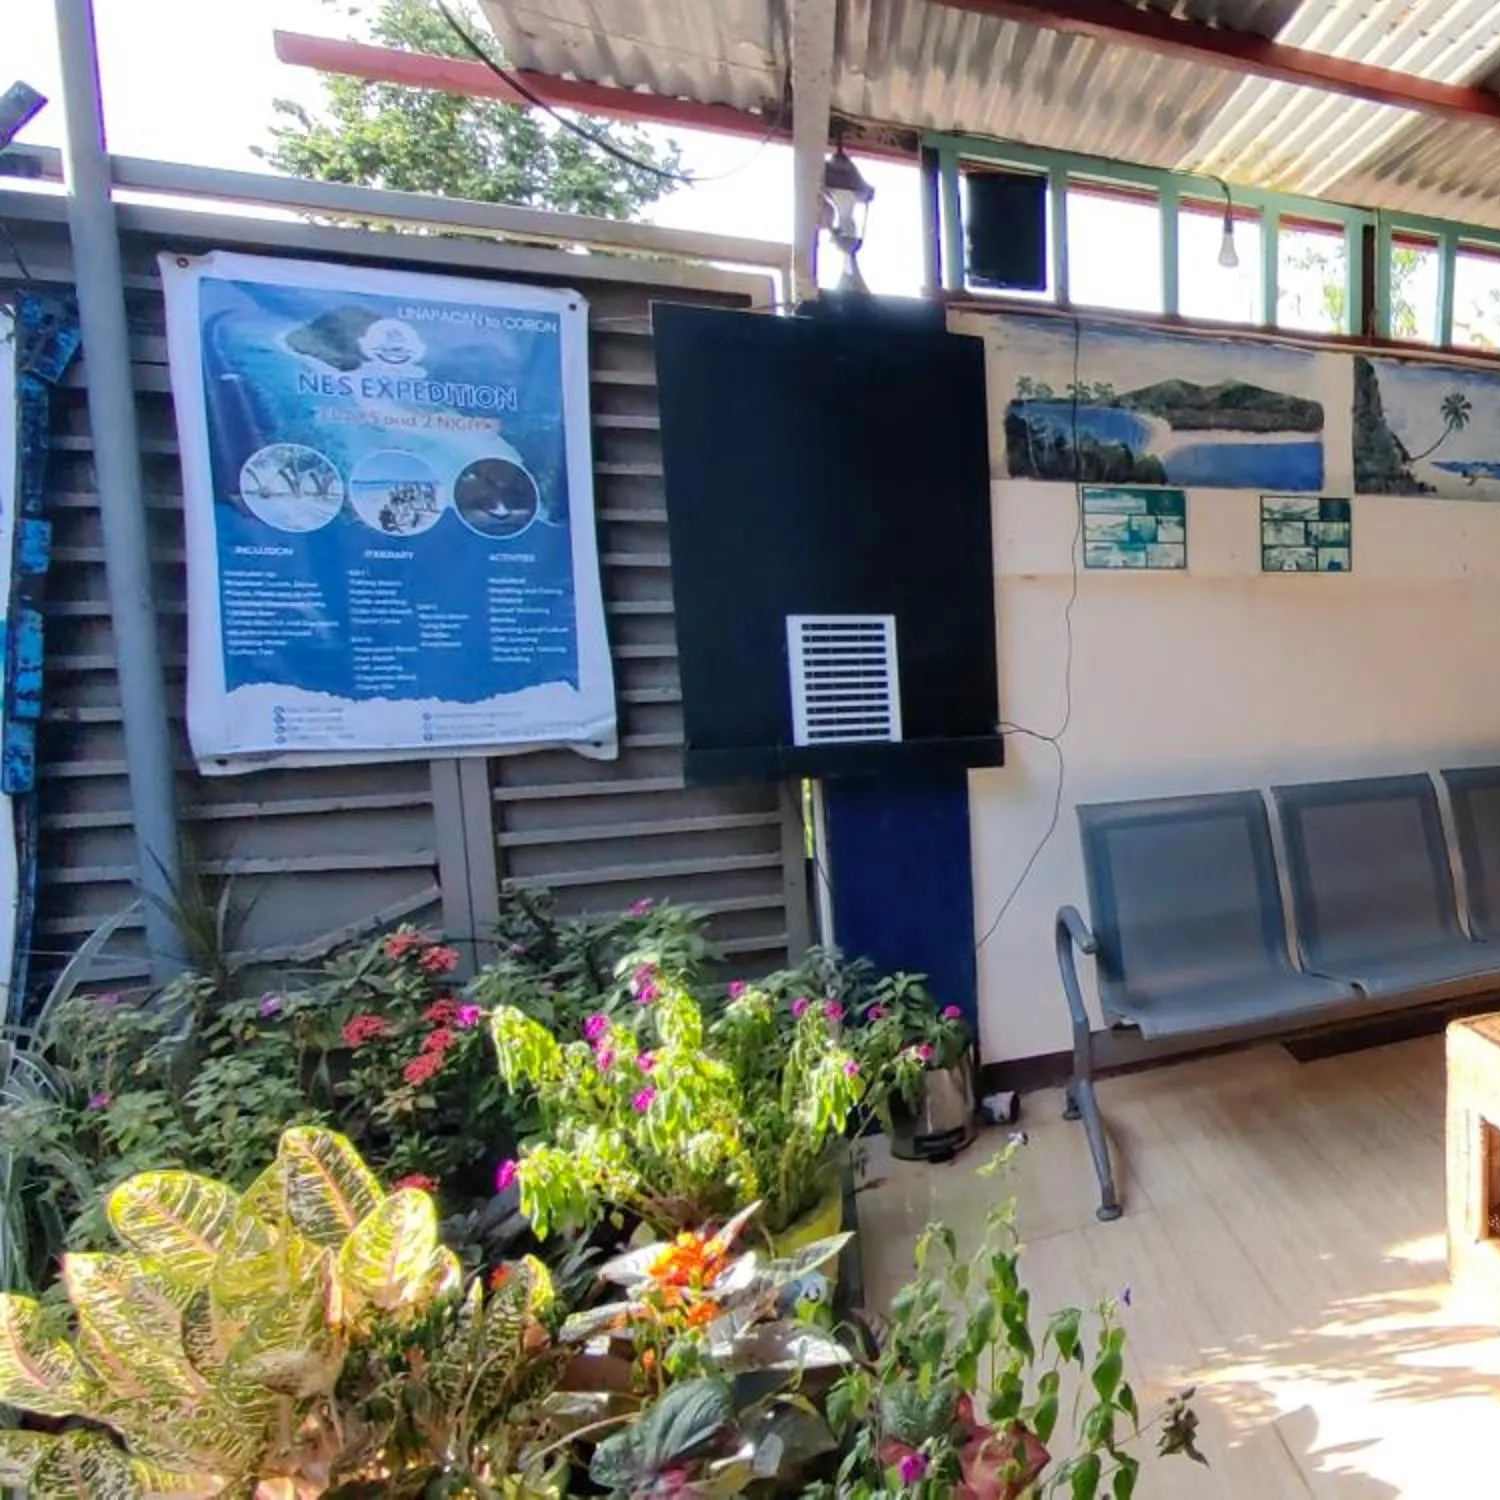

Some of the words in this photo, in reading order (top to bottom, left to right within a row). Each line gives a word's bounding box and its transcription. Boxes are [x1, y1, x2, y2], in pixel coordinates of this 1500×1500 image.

[503, 315, 559, 334] CORON
[298, 373, 353, 396] NES
[361, 376, 518, 411] EXPEDITION
